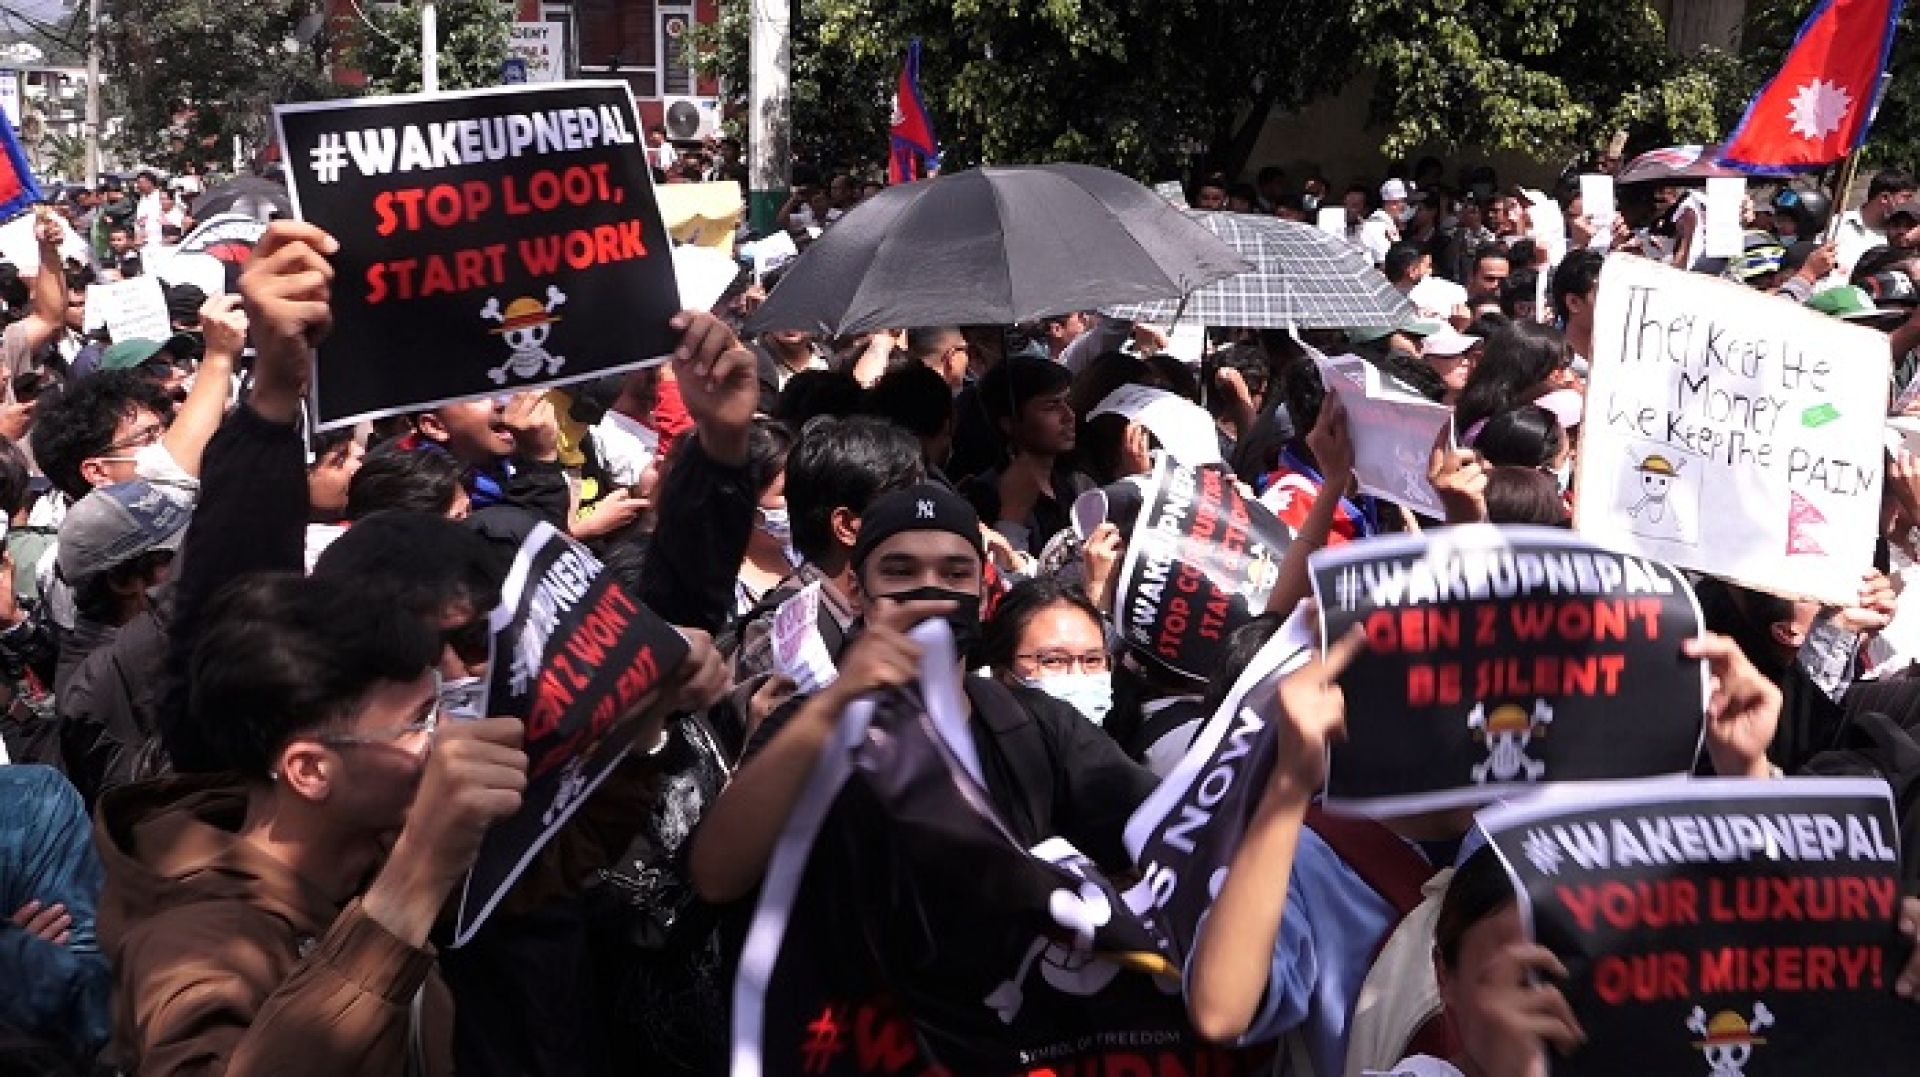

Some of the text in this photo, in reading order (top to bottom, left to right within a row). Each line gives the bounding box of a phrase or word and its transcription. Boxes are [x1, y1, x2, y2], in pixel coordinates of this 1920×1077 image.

[309, 104, 634, 184] #WAKEUPNEPAL
[373, 163, 624, 236] STOP LOOT,
[365, 219, 648, 304] START WORK
[1787, 446, 1876, 497] PAIN
[1335, 549, 1673, 611] #WAKEUPNEPAL
[1159, 596, 1191, 659] STOP
[1365, 599, 1662, 652] GEN Z WON'T
[553, 655, 590, 691] Z
[1408, 654, 1624, 706] BE SILENT
[1162, 706, 1264, 853] NOW
[1522, 814, 1895, 876] #WAKEUPNEPAL
[1554, 876, 1896, 932] YOUR LUXURY
[1594, 945, 1884, 1004] OUR MISERY!
